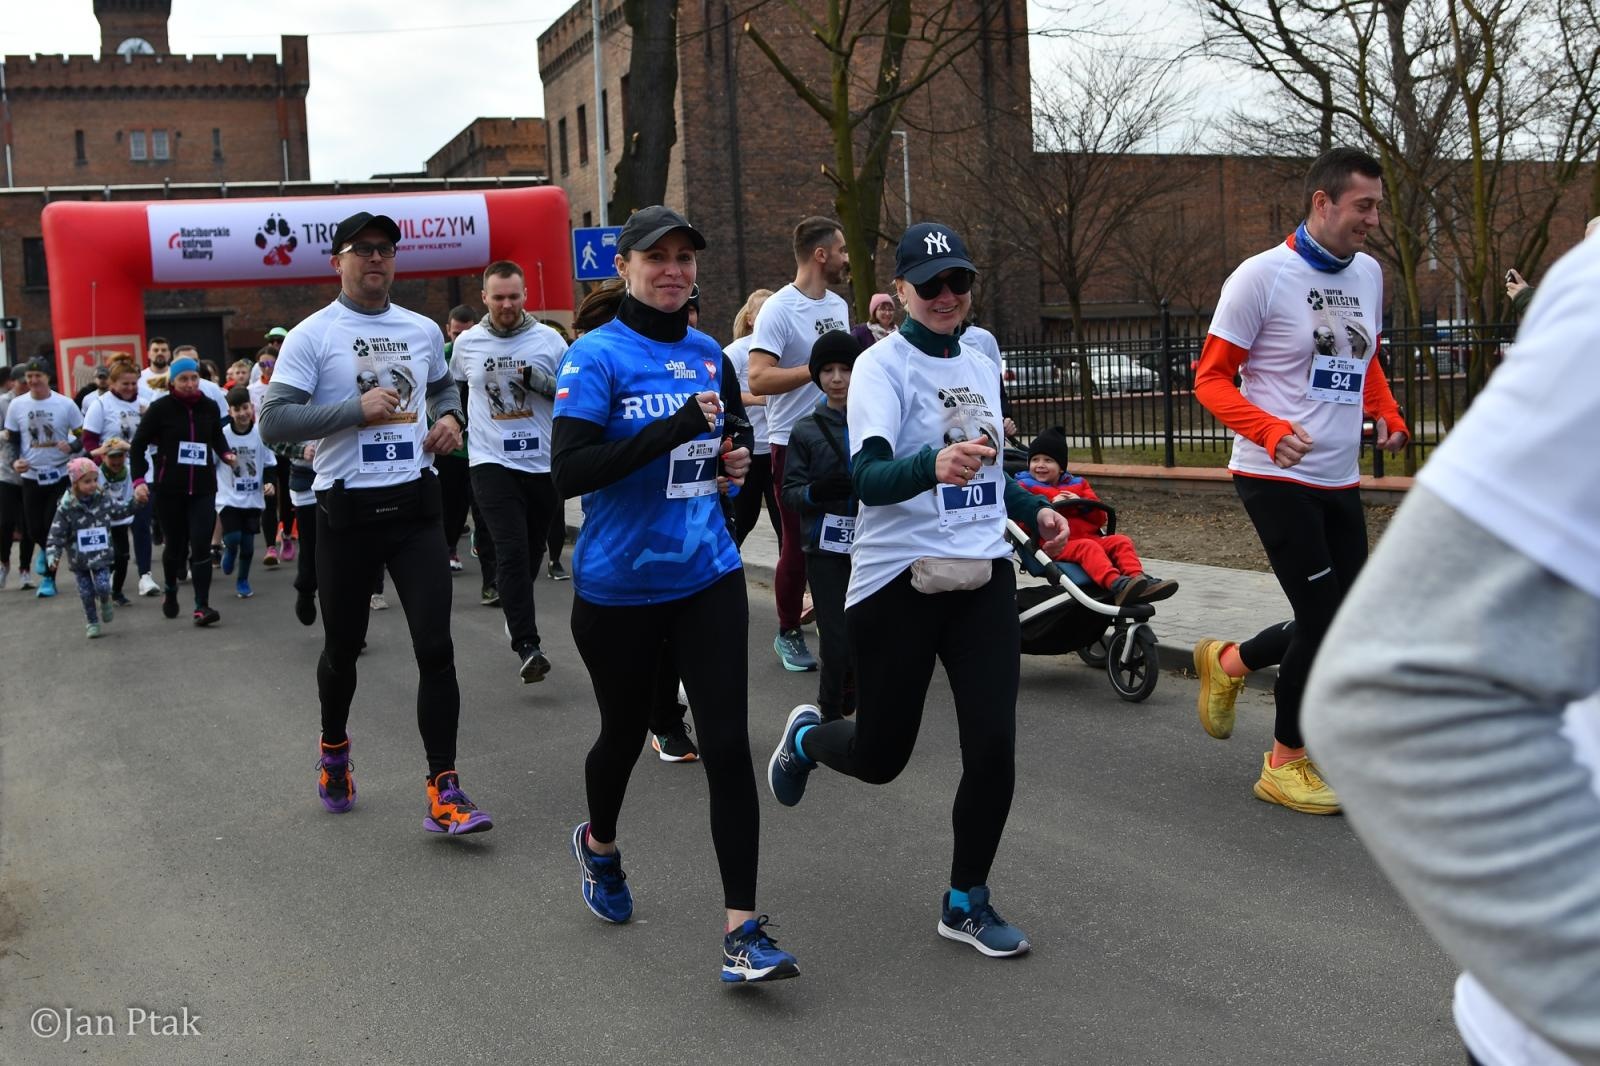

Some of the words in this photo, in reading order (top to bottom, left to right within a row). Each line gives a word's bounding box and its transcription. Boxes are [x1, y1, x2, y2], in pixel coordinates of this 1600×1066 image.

[180, 227, 230, 237] Raciborskie
[923, 231, 952, 255] NY
[182, 248, 213, 260] Kultury
[1325, 296, 1360, 306] WILCZYM
[371, 342, 409, 351] WILCZYM
[497, 360, 527, 368] WILCZYM
[1330, 372, 1351, 390] 94
[955, 393, 987, 405] WILCZYM
[519, 439, 528, 450] 9
[385, 444, 397, 460] 8
[695, 459, 706, 481] 7
[961, 485, 983, 506] 70
[88, 535, 101, 545] 45
